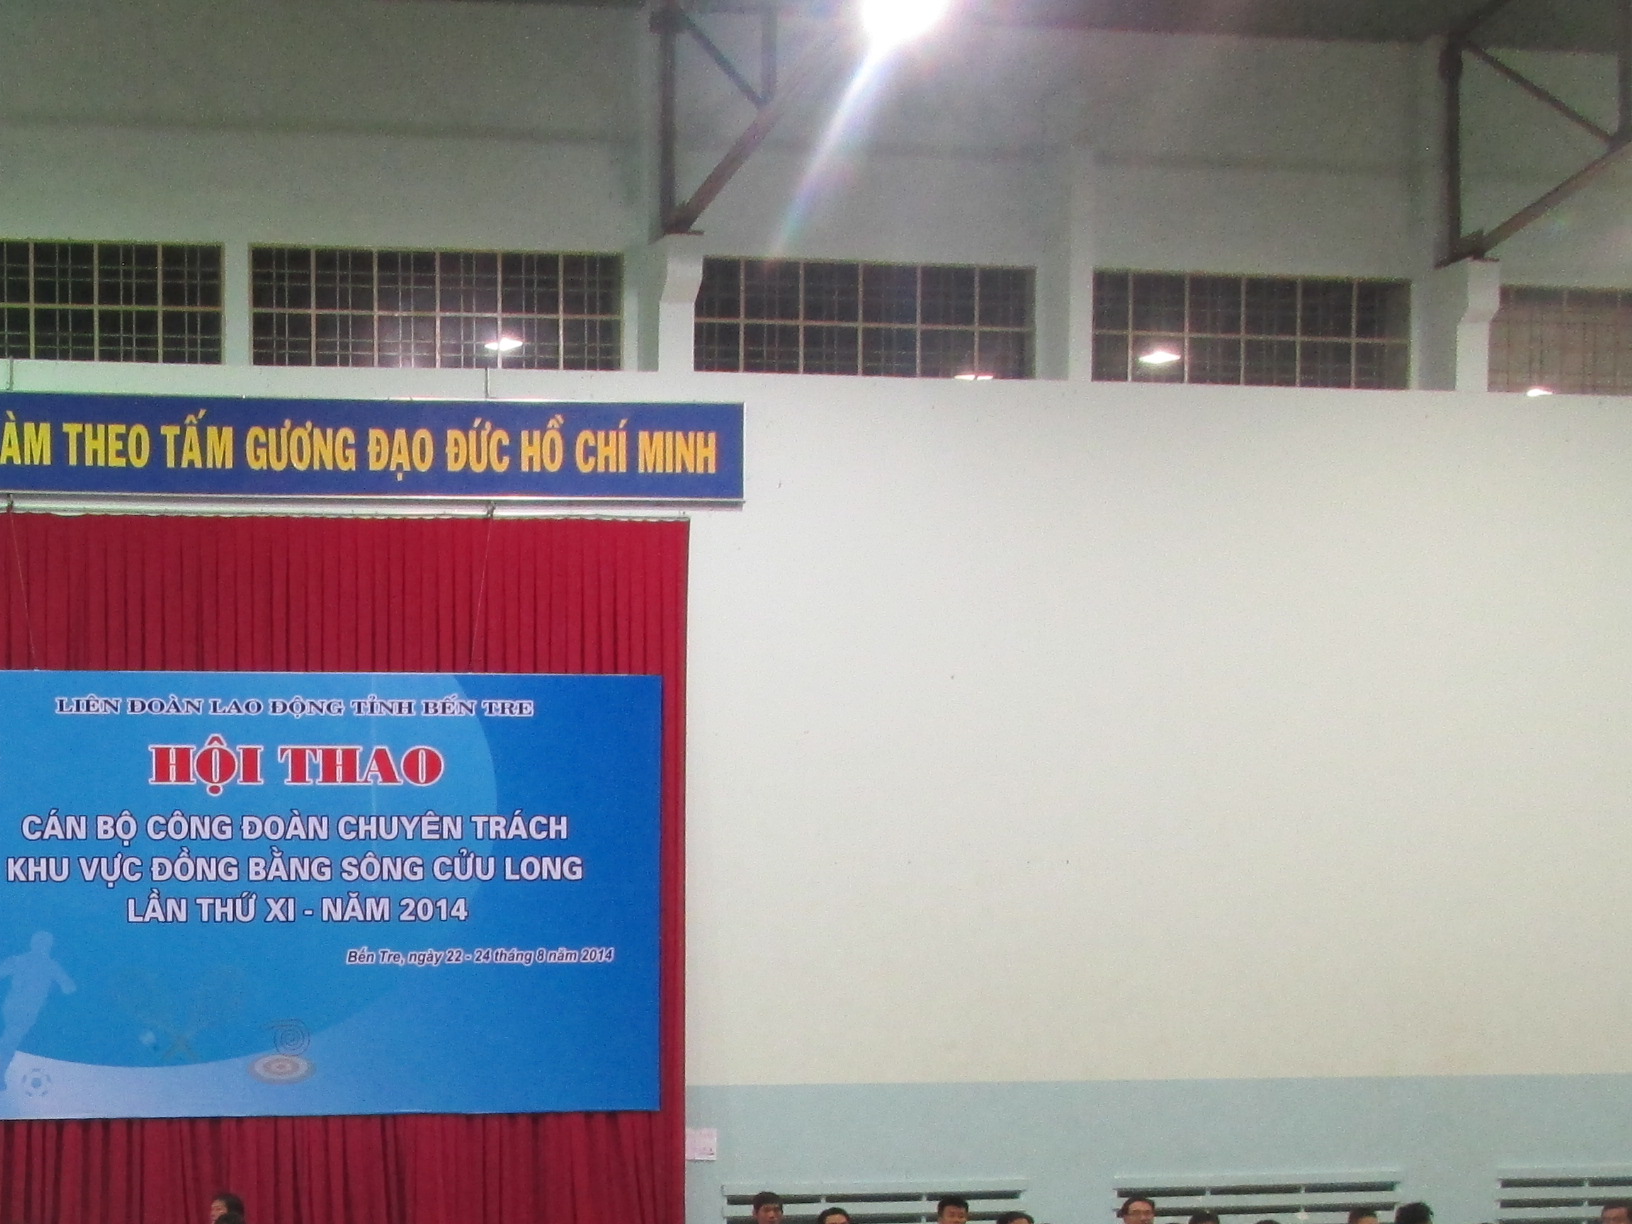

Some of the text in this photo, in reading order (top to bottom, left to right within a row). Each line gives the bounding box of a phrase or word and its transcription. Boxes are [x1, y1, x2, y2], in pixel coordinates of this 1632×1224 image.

[63, 423, 149, 468] THEO
[161, 409, 233, 469] TẤM
[246, 419, 355, 471] GƯƠNG
[368, 428, 433, 481] ĐẠO
[446, 417, 509, 473] ĐỨC
[520, 413, 564, 473] HỒ
[575, 419, 627, 473] CHÍ
[638, 431, 716, 474] MINH
[56, 694, 534, 719] LIÊN ĐOÀN LAO ĐỘNG TỈNH BẾN TRE
[149, 734, 444, 796] HỘI THAO
[22, 810, 568, 846] CÁN BỘ CÔNG ĐOÀN CHUYÊN TRÁCH
[7, 847, 583, 888] KHU VỰC ĐỒNG BẰNG SÔNG CỬU LONG
[126, 889, 187, 923] LẦN
[196, 892, 256, 923] THỨ
[265, 898, 295, 922] XI
[322, 892, 390, 922] NĂM
[399, 898, 468, 921] 2014
[347, 947, 374, 964] Bến
[379, 949, 404, 965] Tre,
[408, 949, 442, 966] ngày
[445, 949, 462, 964] 22
[474, 949, 490, 963] 24
[494, 948, 532, 966] tháng
[536, 949, 545, 963] 8
[548, 948, 577, 963] năm
[580, 947, 614, 963] 2014
